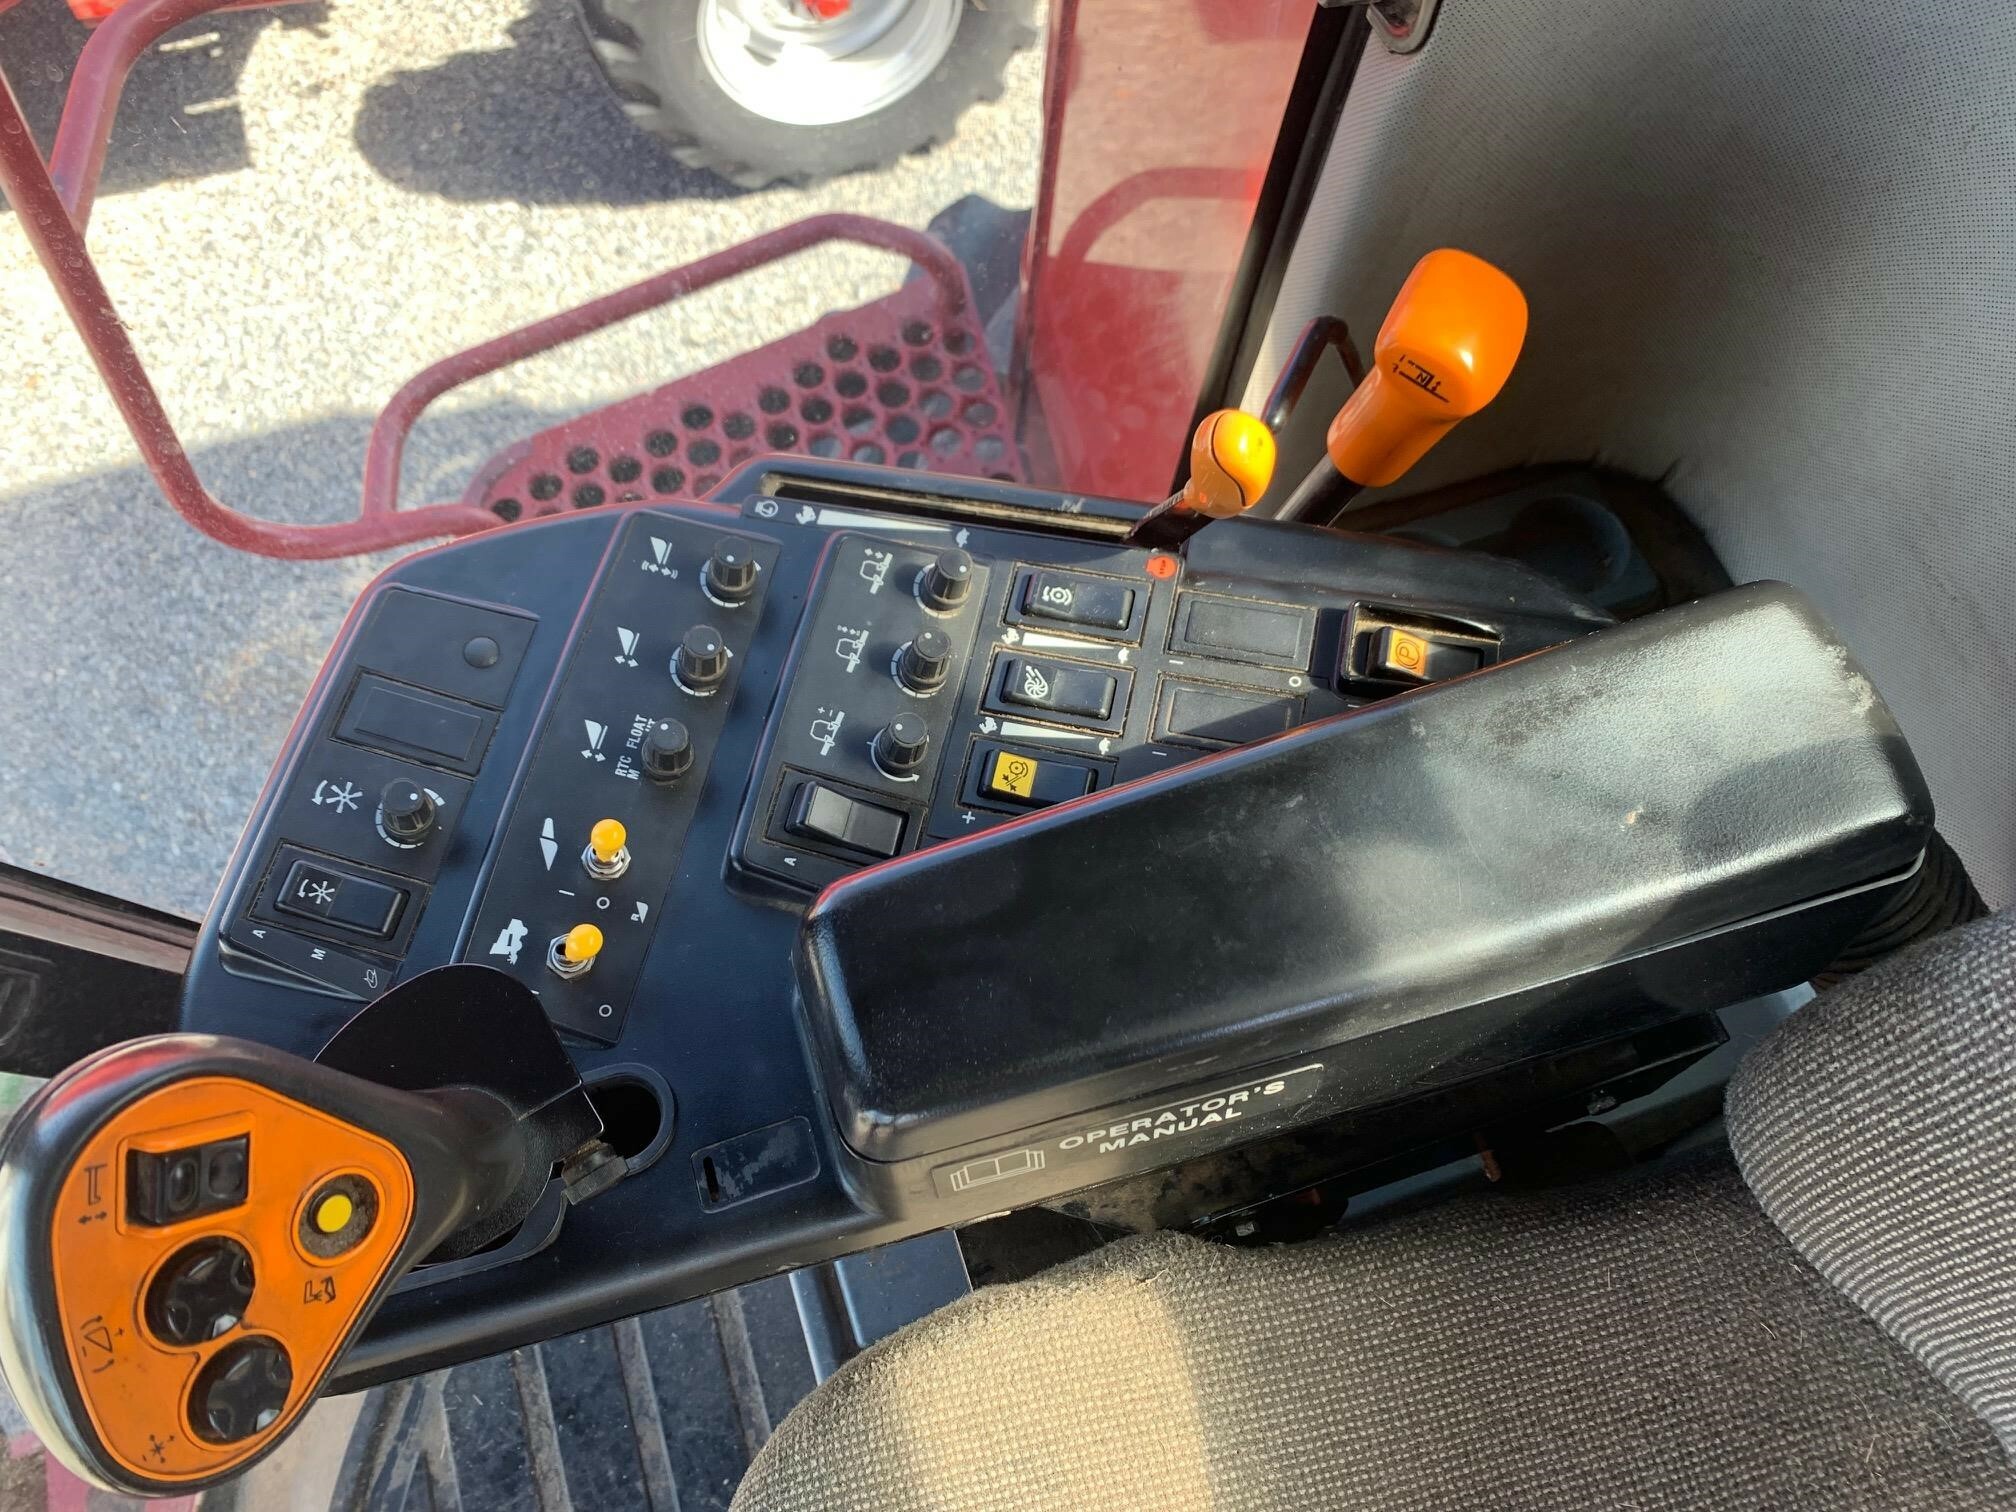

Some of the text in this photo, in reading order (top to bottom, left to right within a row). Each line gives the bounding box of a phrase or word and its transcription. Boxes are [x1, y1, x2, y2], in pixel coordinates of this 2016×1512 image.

[626, 714, 648, 749] FLOAT
[615, 755, 632, 777] RTC
[627, 769, 640, 780] M
[784, 857, 797, 867] A
[252, 929, 267, 939] A
[310, 948, 326, 961] M
[1059, 1081, 1285, 1150] OPERATOR'S
[1100, 1108, 1242, 1153] MANUAL
